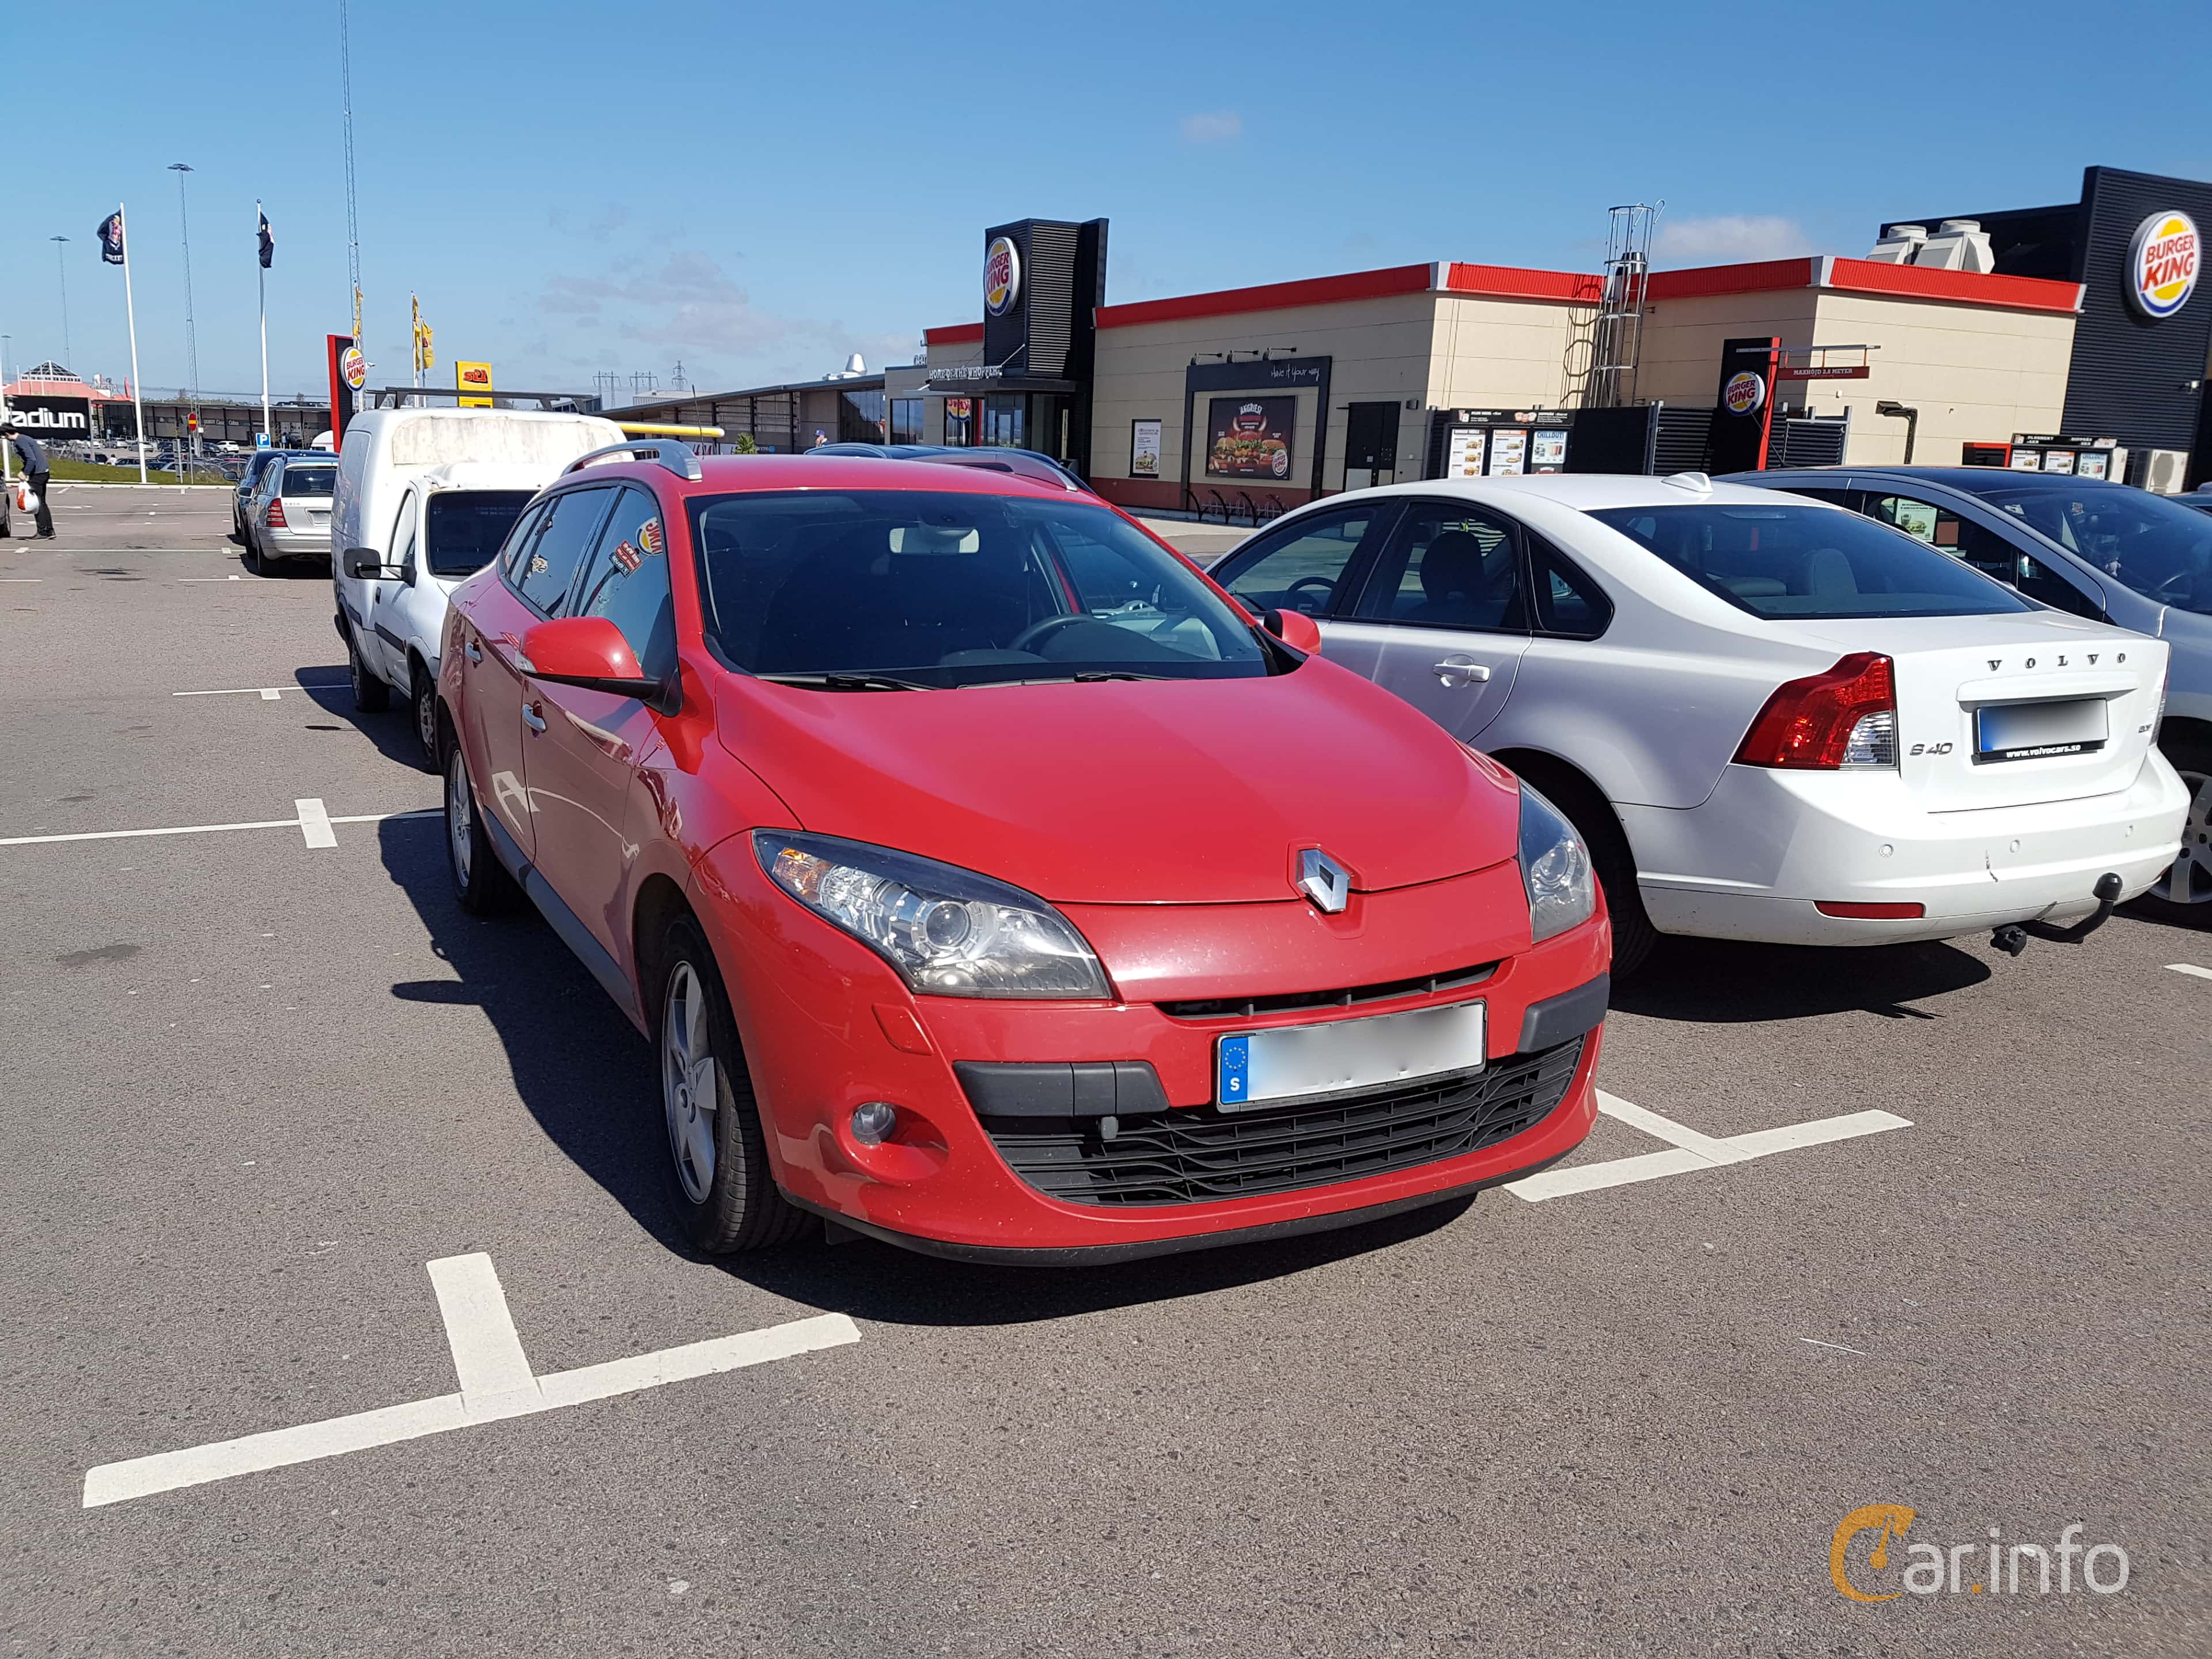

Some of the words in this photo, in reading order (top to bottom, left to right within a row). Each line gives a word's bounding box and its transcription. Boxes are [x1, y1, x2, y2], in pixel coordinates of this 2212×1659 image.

[2145, 234, 2194, 265] BURGER
[986, 252, 1009, 276] BURGER
[2142, 252, 2194, 291] KING
[986, 264, 1009, 294] KING
[346, 357, 363, 370] BURGER
[347, 365, 365, 381] KING
[1728, 380, 1756, 394] BURGER
[1728, 388, 1756, 406] KING
[3, 407, 85, 429] tadium
[260, 434, 268, 445] P
[1987, 653, 2127, 672] VOLVO
[1230, 1077, 1240, 1092] S
